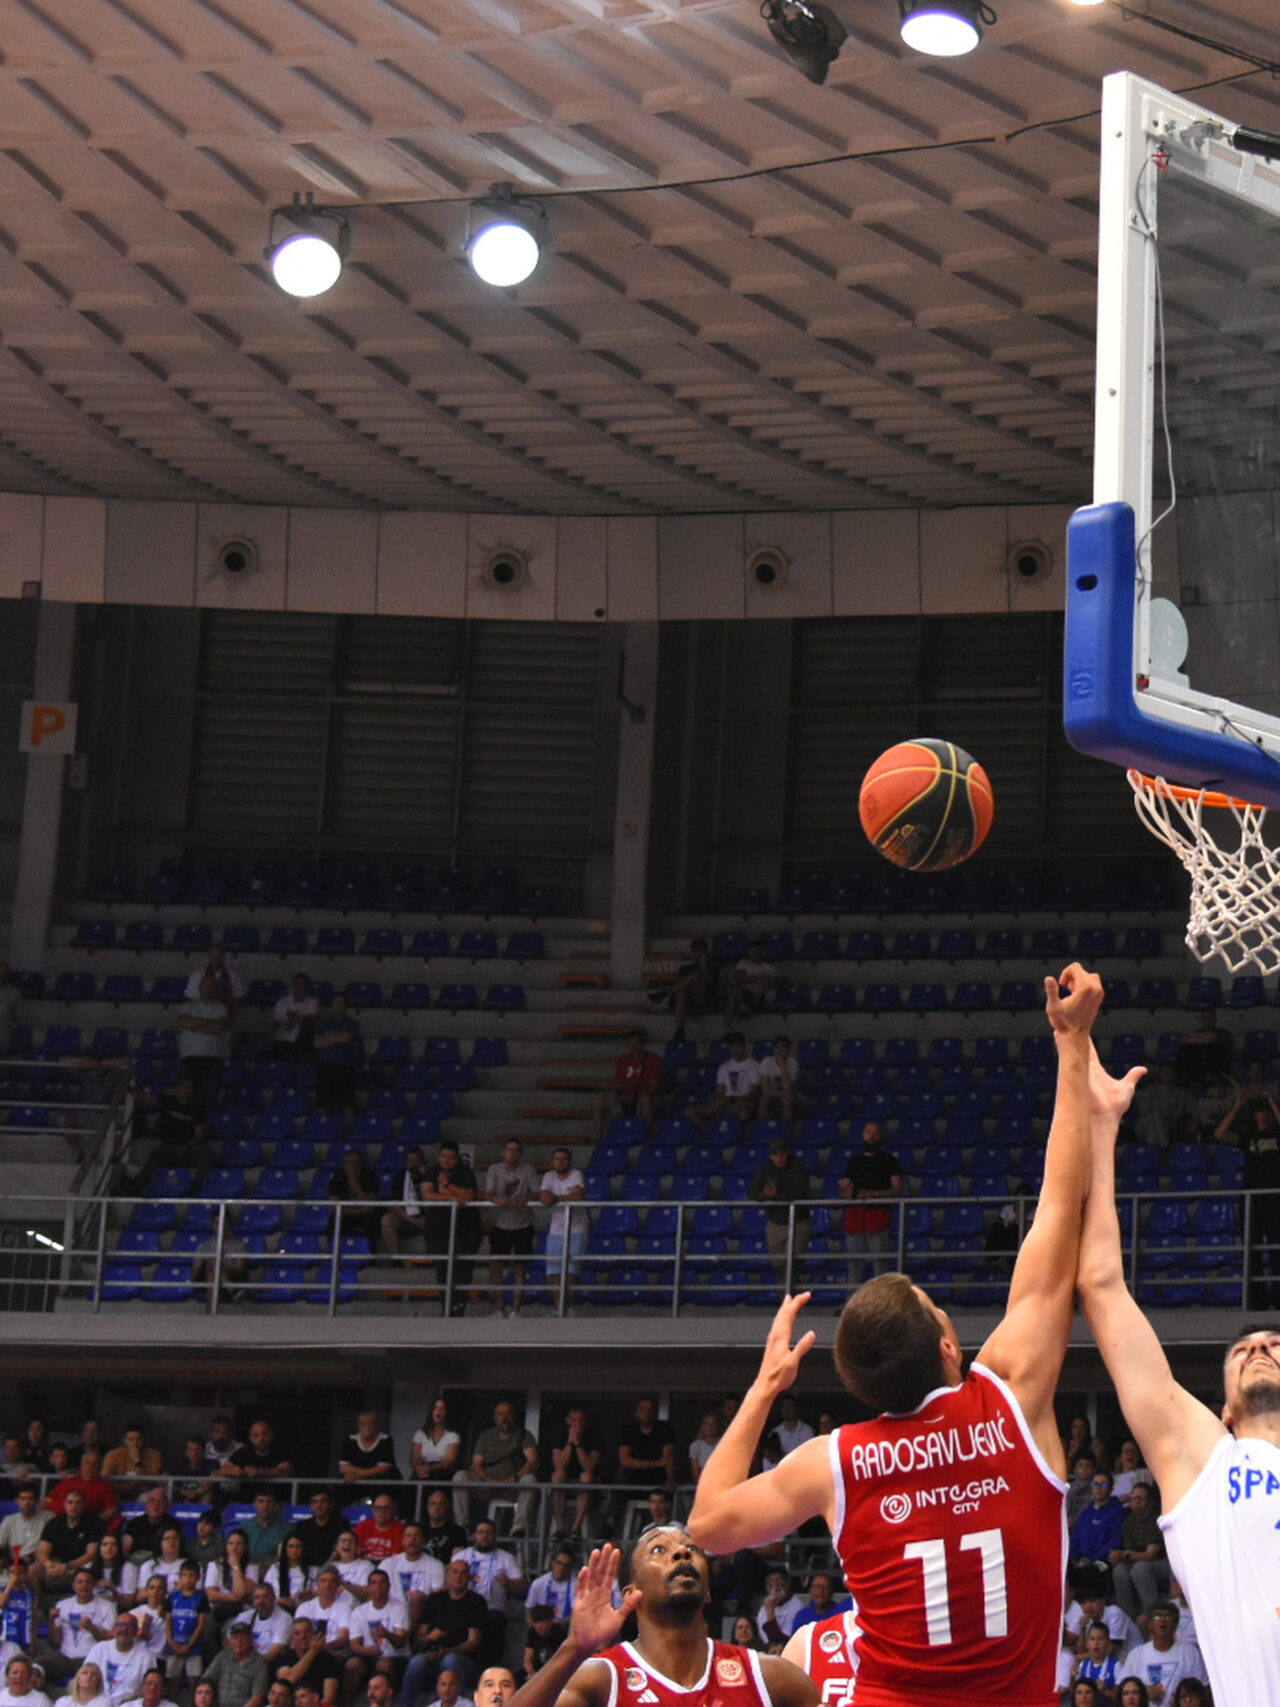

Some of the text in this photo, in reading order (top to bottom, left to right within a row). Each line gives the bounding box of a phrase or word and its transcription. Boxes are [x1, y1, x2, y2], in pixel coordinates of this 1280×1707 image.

[30, 706, 67, 748] P
[851, 1410, 1015, 1481] RADOSAVLJEVIĆ
[916, 1475, 1010, 1508] INTEGRA
[952, 1500, 981, 1515] CITY
[903, 1528, 1008, 1647] 11
